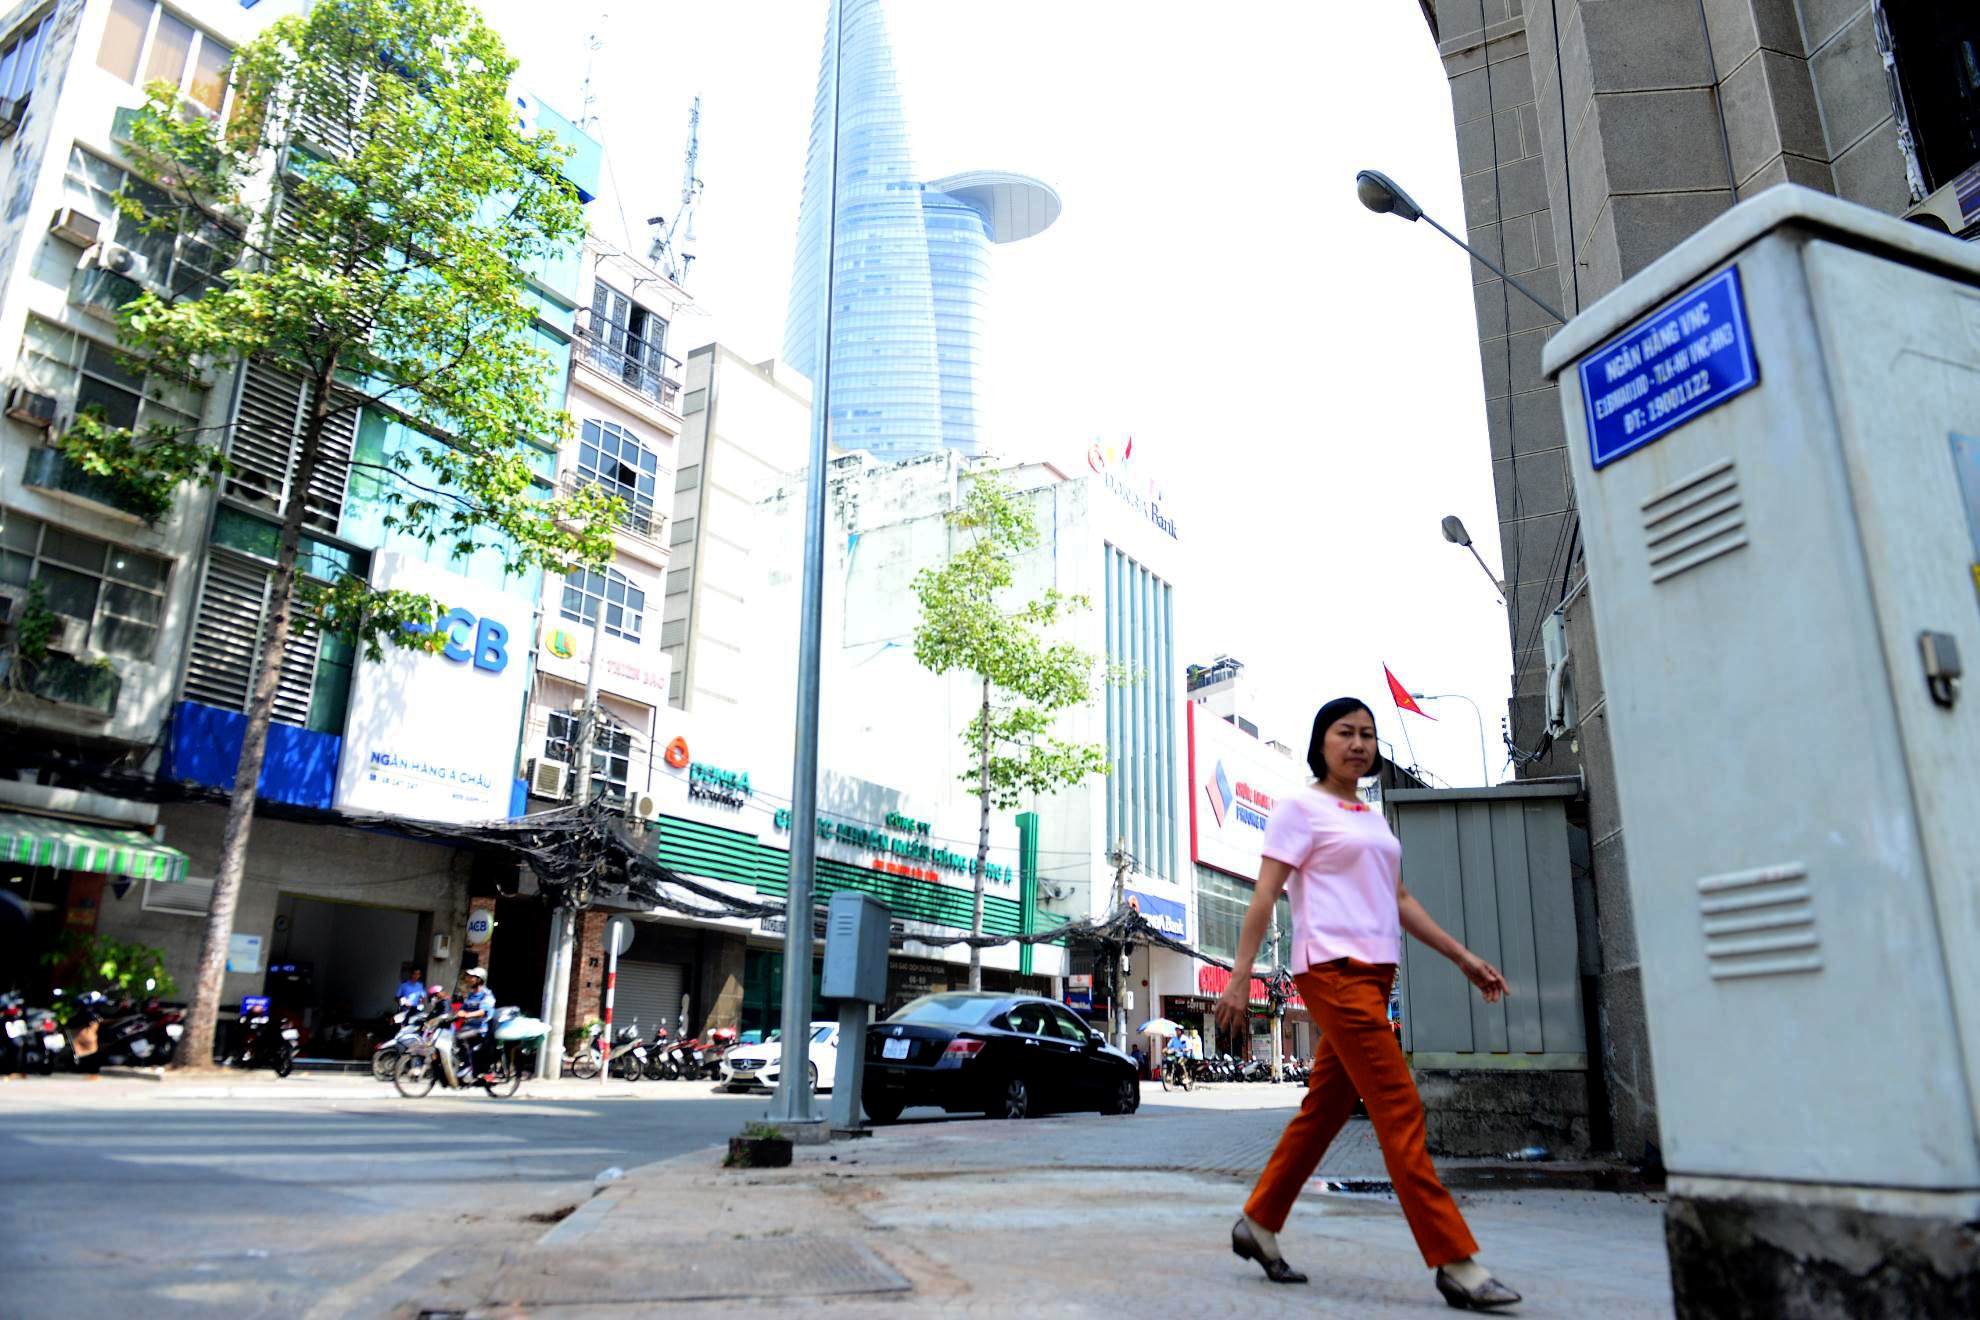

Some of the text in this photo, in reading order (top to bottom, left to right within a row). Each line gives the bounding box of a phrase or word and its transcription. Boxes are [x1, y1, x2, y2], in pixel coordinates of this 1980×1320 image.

[1604, 344, 1642, 383] NGÂN
[1641, 327, 1681, 361] HÀNG
[1647, 369, 1711, 422] 19001122
[1152, 502, 1178, 541] Bank
[469, 921, 487, 931] ACB
[1165, 914, 1184, 935] Bank
